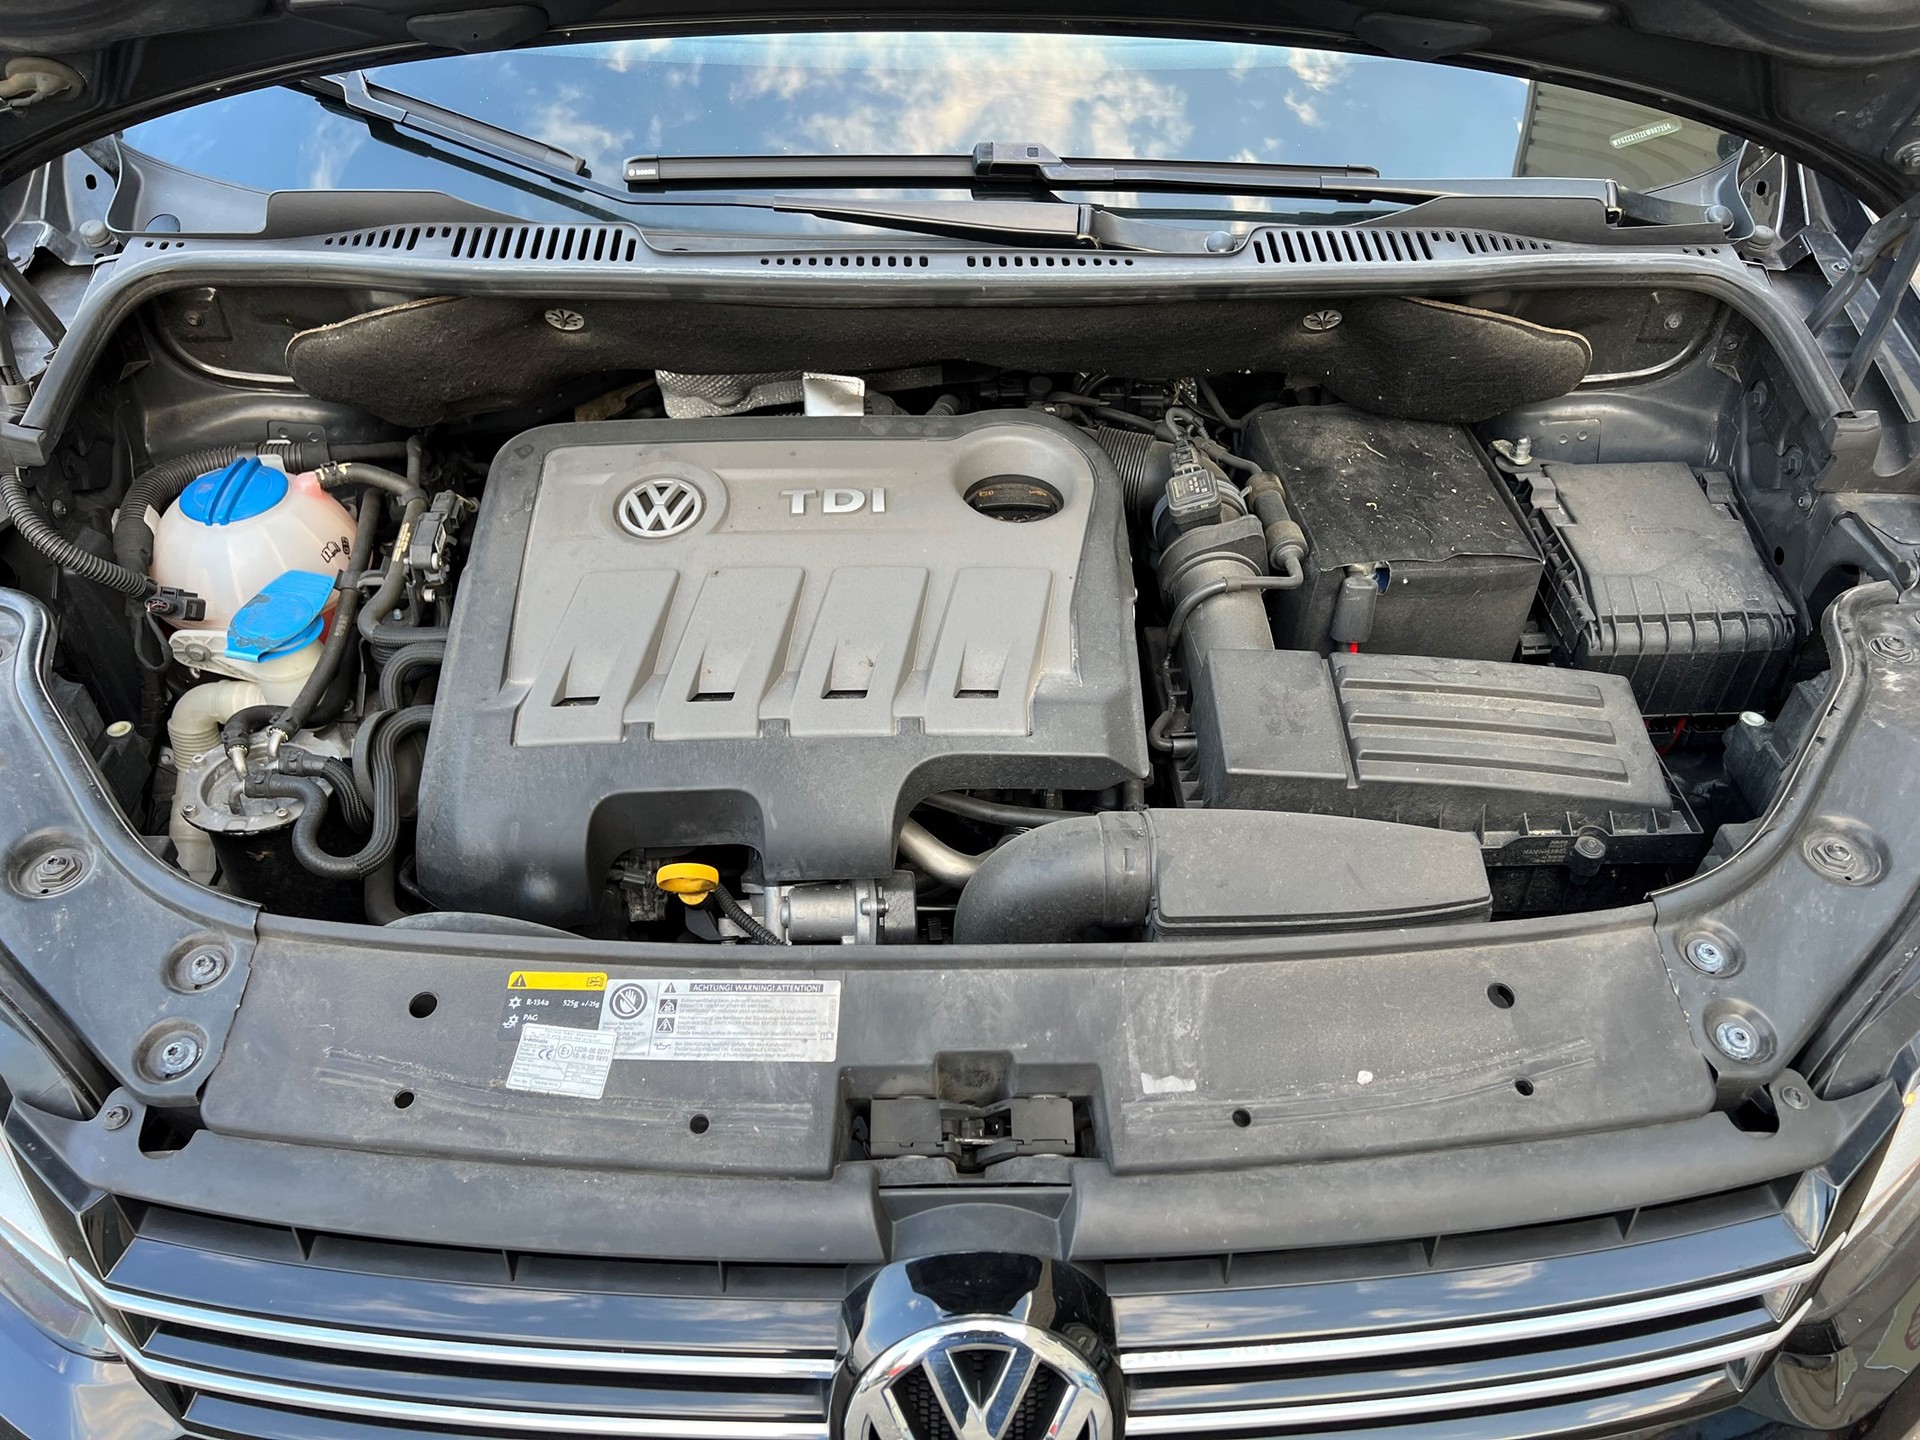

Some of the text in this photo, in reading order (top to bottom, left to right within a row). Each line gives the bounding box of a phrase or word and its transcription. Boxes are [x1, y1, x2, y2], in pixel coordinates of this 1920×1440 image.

[780, 487, 886, 515] TDI
[692, 983, 822, 992] ACHTUNG! WARNING! ATTENTION!
[526, 998, 550, 1006] R-134a
[562, 999, 579, 1009] 525g
